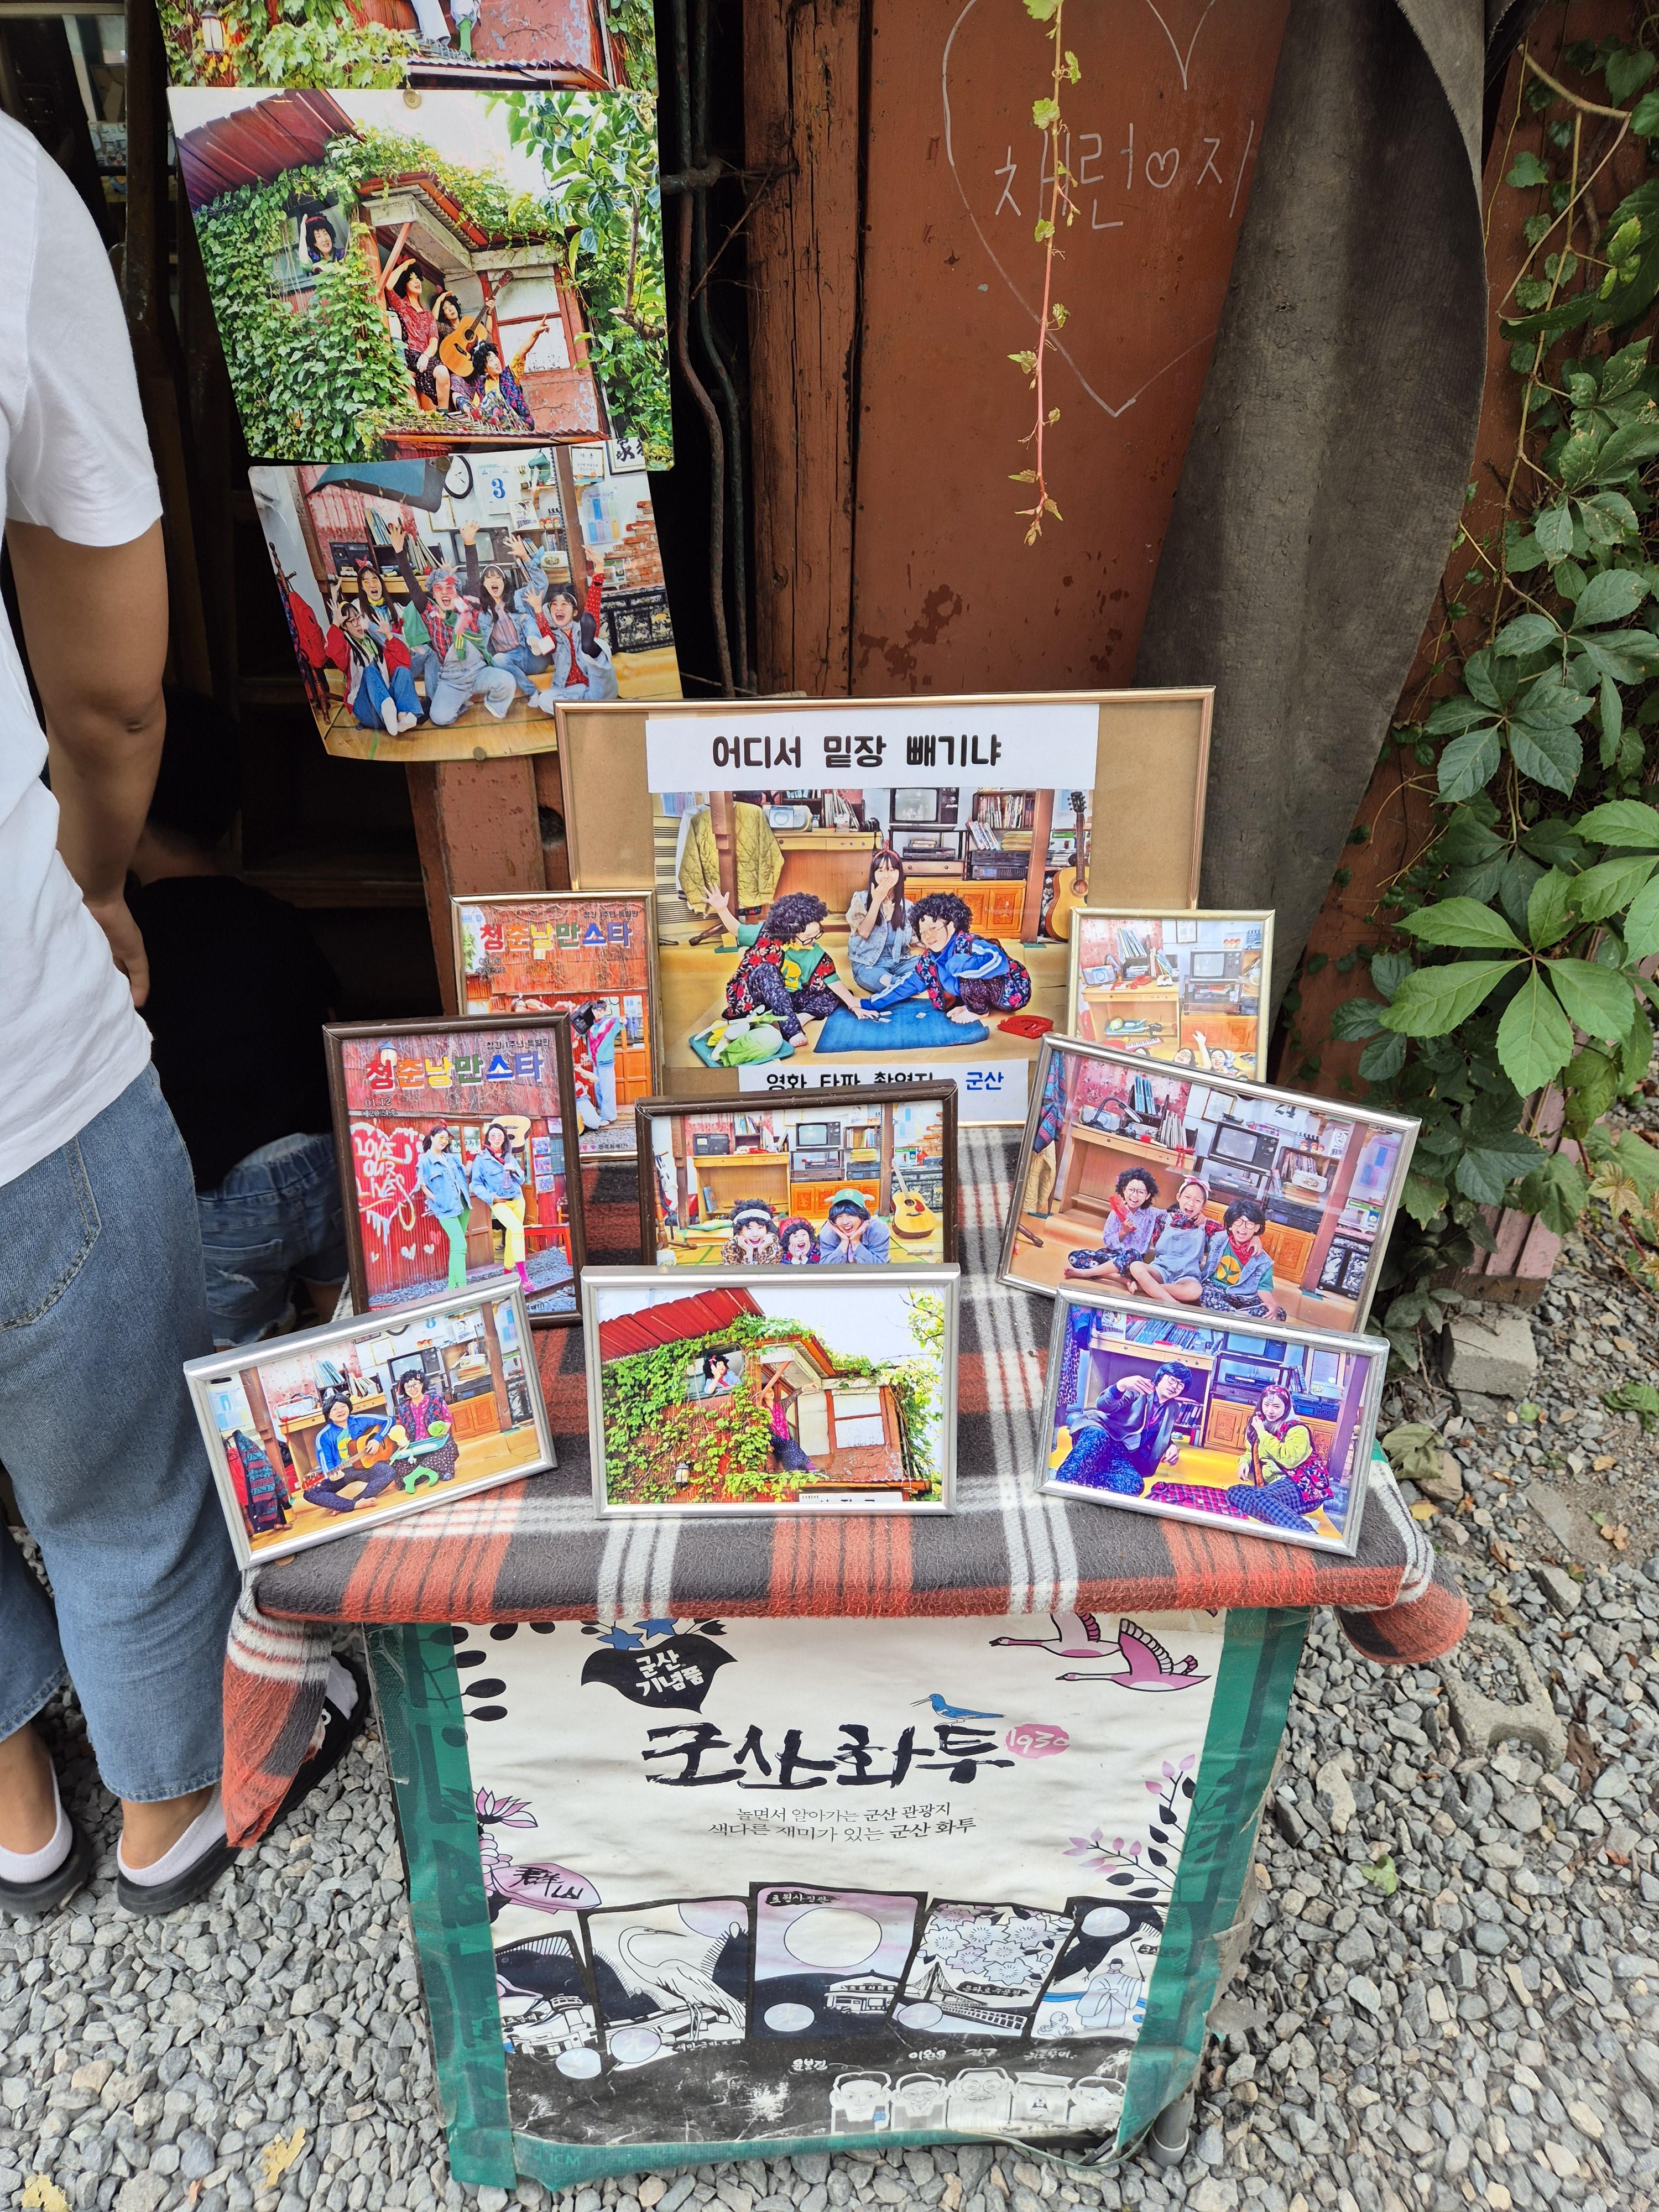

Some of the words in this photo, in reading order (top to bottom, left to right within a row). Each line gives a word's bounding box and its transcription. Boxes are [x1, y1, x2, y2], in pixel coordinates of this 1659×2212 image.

[492, 478, 506, 499] 3
[712, 734, 802, 769] 어디서
[823, 733, 885, 768] 밑장
[906, 732, 1001, 768] 빼기냐
[479, 920, 633, 953] 청춘낭만스타
[487, 1041, 502, 1050] 창간
[505, 1040, 524, 1048] 1주년
[528, 1038, 550, 1047] 특별판
[365, 1052, 544, 1091] 청춘낭만스타
[766, 1073, 807, 1090] 영화
[965, 1071, 1004, 1091] 군산
[365, 1097, 392, 1107] 01.12
[635, 1648, 680, 1678] 군산
[635, 1665, 704, 1697] 기념품
[1010, 1727, 1070, 1754] 1930
[641, 1721, 1016, 1790] 군산화투
[736, 1807, 786, 1822] 놀면서
[791, 1808, 859, 1823] 알아가는
[864, 1807, 898, 1821] 군산
[901, 1802, 951, 1818] 관광지
[708, 1823, 770, 1837] 색다른
[775, 1825, 838, 1843] 재미가
[844, 1826, 884, 1842] 있는
[889, 1822, 932, 1839] 군산
[935, 1817, 977, 1835] 화투
[769, 1892, 829, 1903] 초원사진관
